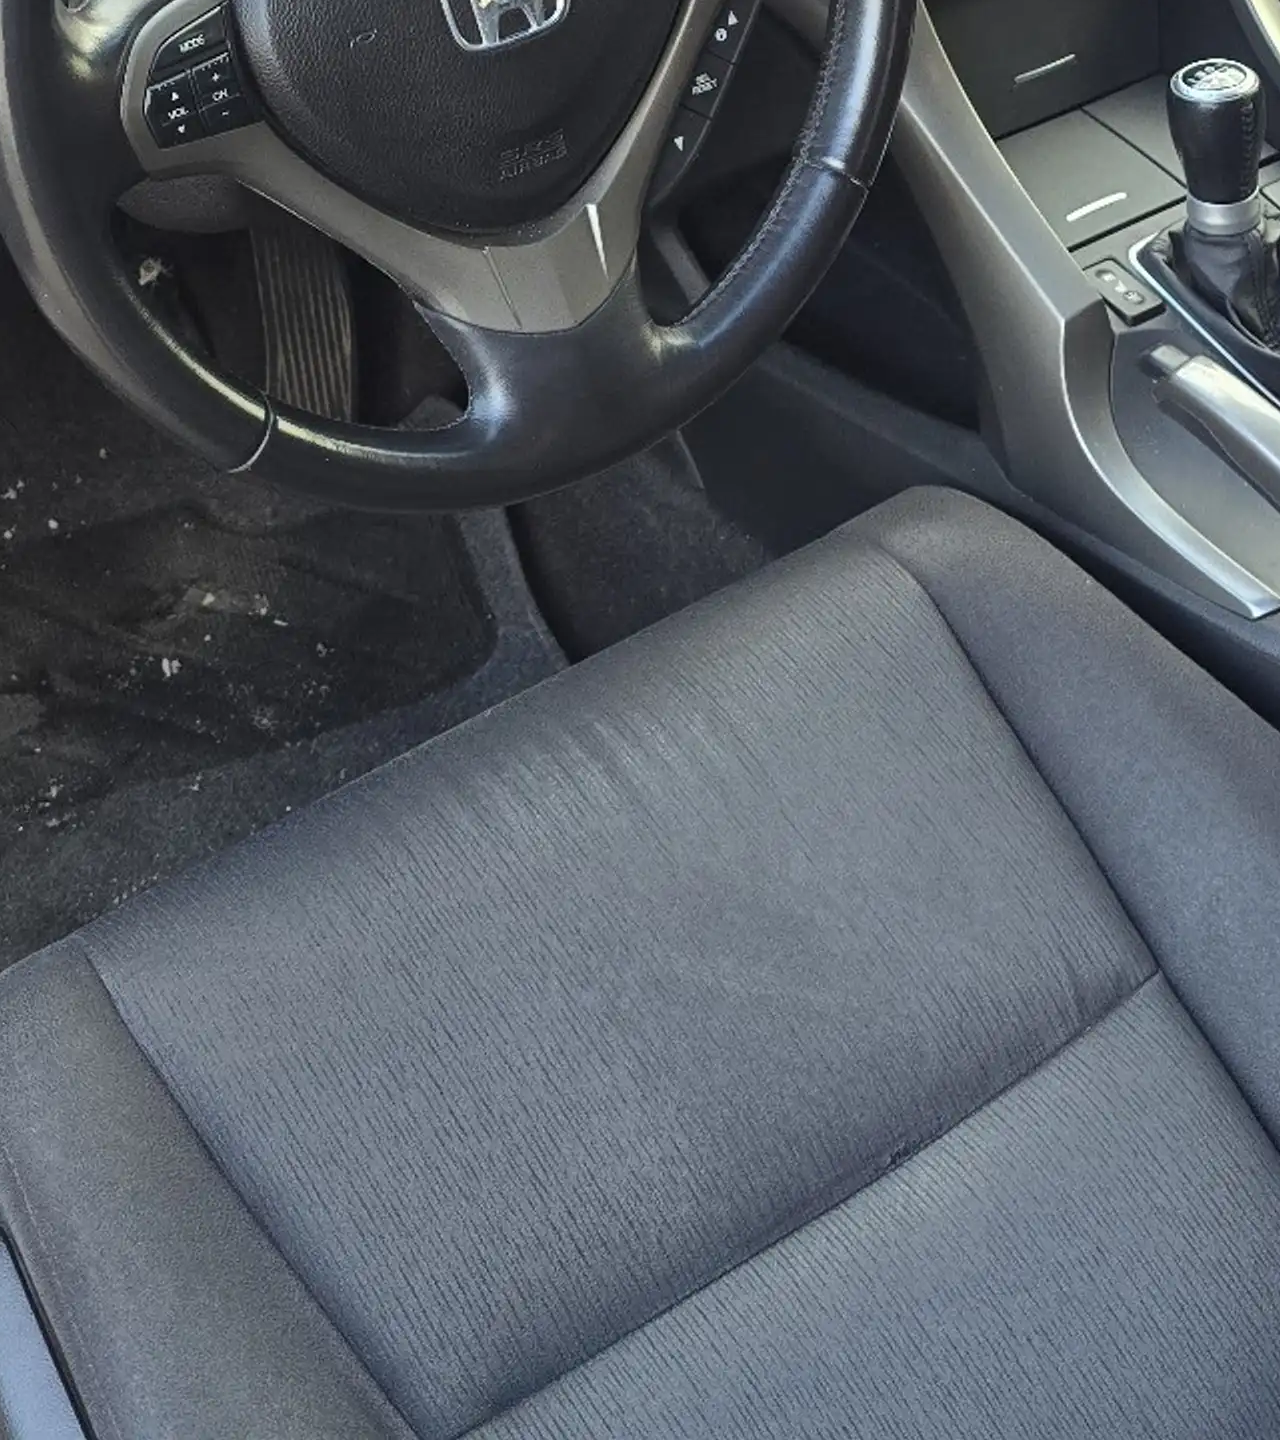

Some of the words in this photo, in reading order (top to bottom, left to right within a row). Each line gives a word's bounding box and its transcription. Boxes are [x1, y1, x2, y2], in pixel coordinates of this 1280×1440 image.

[178, 33, 206, 54] MODE
[211, 87, 229, 102] CH
[167, 106, 189, 120] VOL
